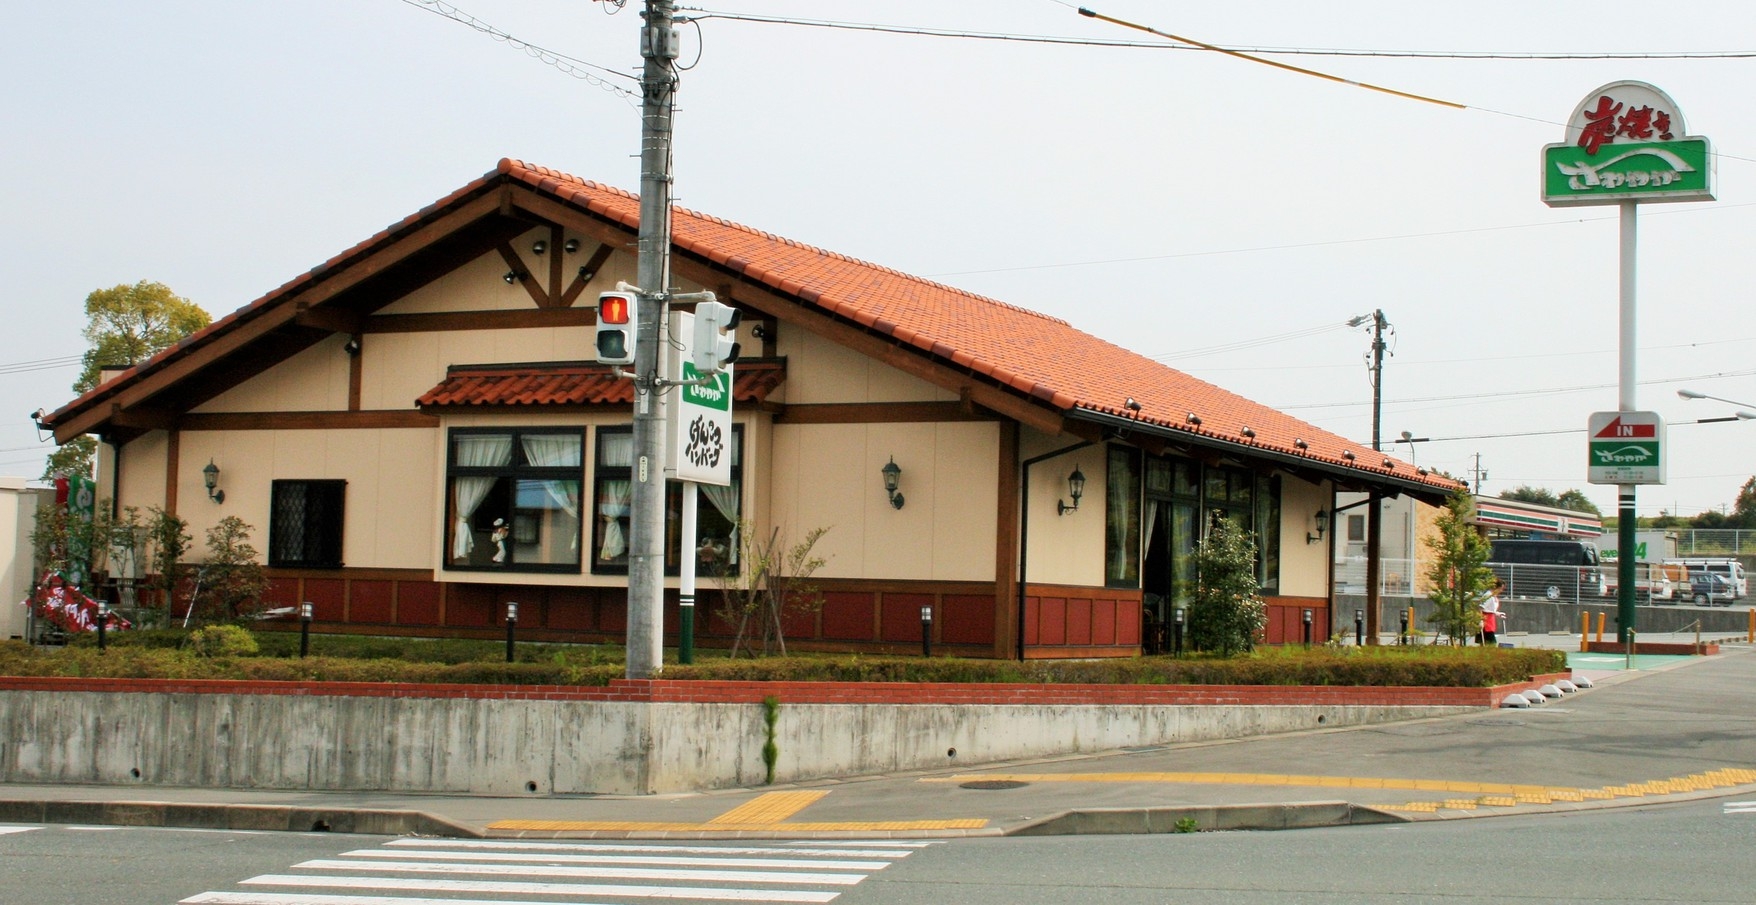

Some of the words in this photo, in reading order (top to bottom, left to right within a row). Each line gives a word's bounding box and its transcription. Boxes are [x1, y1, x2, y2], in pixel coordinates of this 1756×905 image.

[1577, 95, 1674, 155] 炭焼き
[1556, 148, 1697, 190] さわやか
[689, 414, 722, 450] げんこつ
[1617, 425, 1633, 436] IN
[685, 442, 723, 468] ハンバーグ
